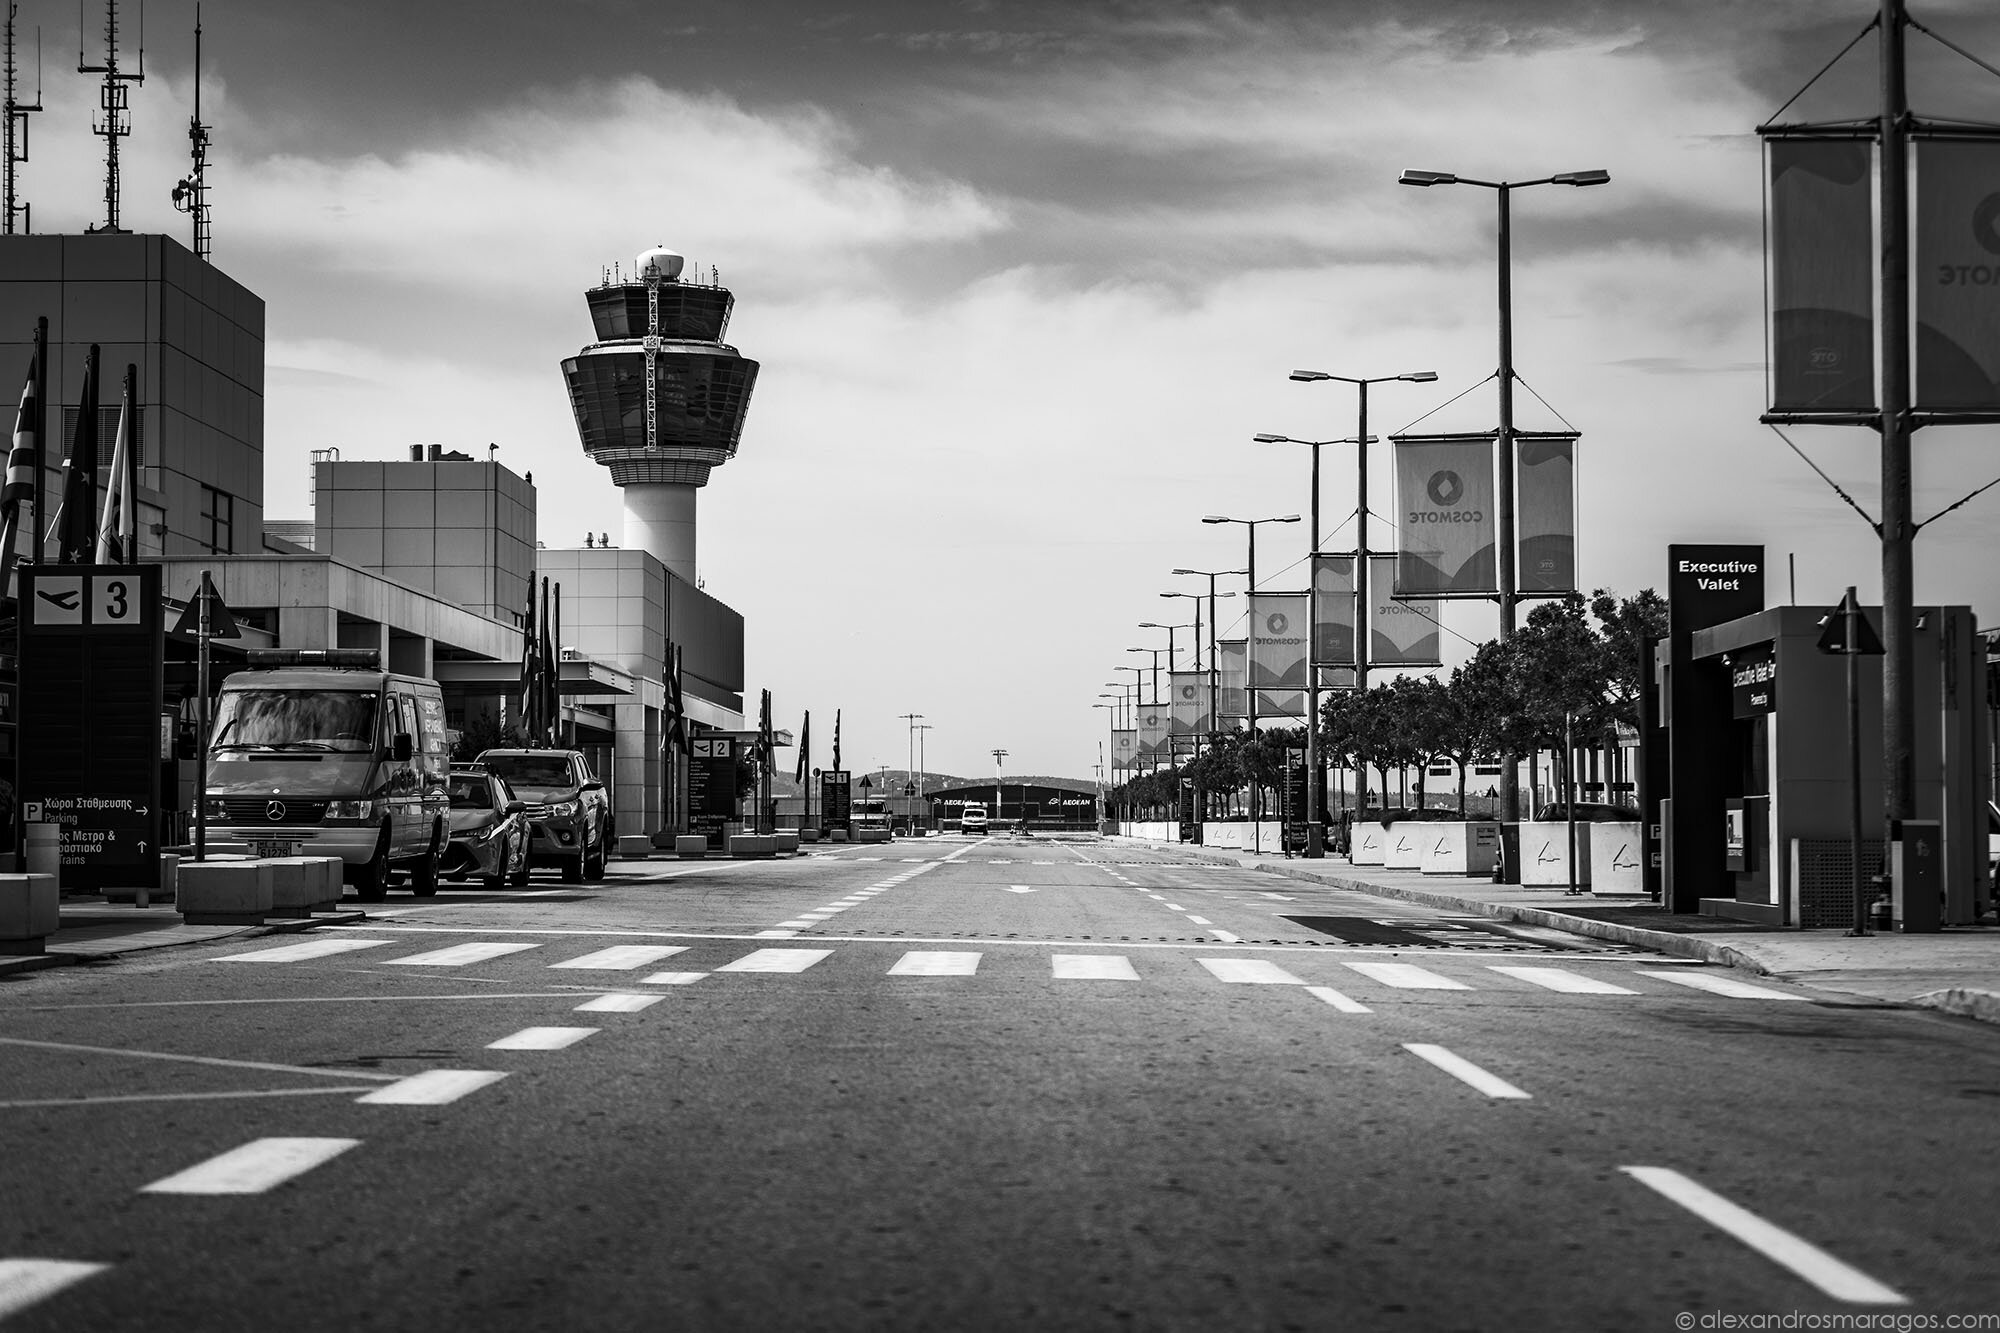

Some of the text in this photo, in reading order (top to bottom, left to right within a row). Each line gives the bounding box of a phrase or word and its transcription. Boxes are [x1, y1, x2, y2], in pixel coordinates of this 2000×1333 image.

[1679, 560, 1757, 573] Executive
[1697, 578, 1740, 591] Valet
[107, 581, 128, 619] 3
[717, 742, 725, 755] 2
[840, 774, 844, 782] 1
[45, 798, 132, 810] Χώροι Στάθμευσης
[27, 804, 38, 819] P
[45, 812, 78, 825] Parking
[59, 830, 115, 843] ος Μετρο &
[261, 848, 288, 858] 61279
